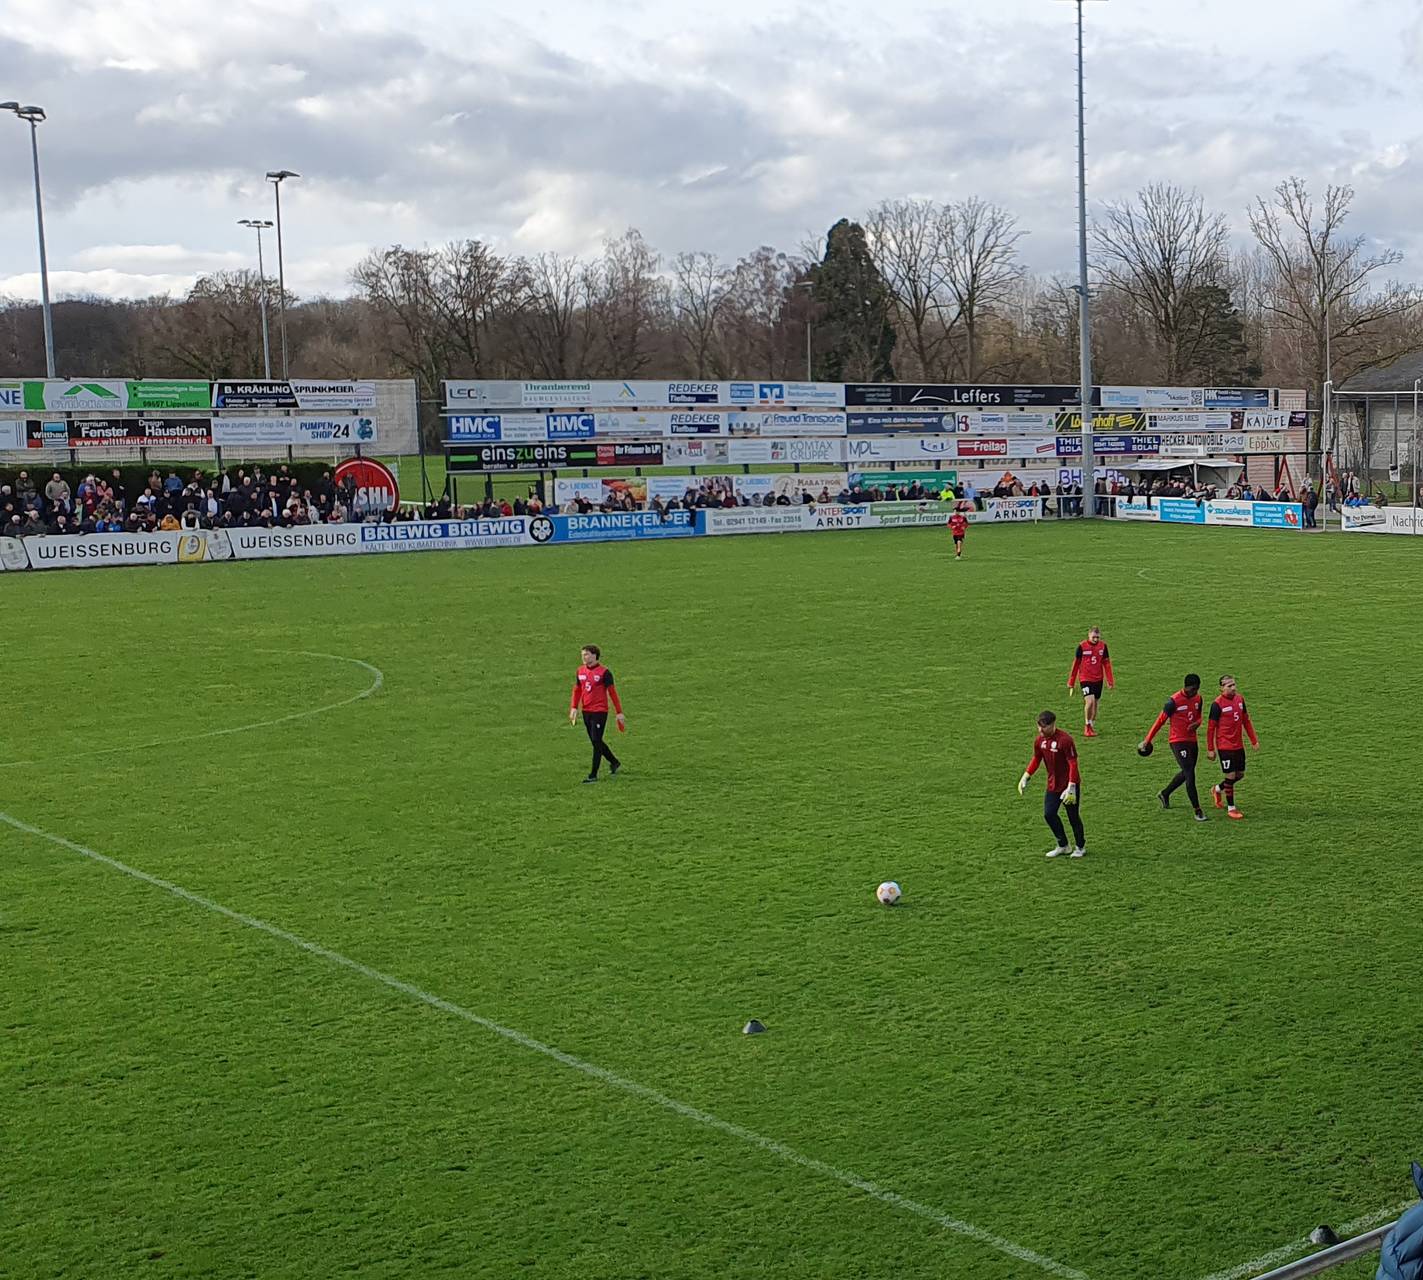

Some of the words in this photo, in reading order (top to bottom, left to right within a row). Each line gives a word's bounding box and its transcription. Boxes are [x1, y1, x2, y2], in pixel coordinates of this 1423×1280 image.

[224, 386, 235, 394] B.
[237, 384, 290, 394] KRÄHLING
[669, 384, 718, 393] REDEKER
[549, 415, 591, 431] HMC
[671, 414, 720, 423] REDEKER
[300, 422, 334, 431] PUMPEN
[333, 424, 349, 438] 24
[451, 417, 496, 433] HMC
[81, 427, 128, 438] Fenster
[145, 425, 207, 437] Haustüren
[311, 431, 333, 439] SHOP
[790, 441, 833, 450] KOMTAX
[974, 441, 1006, 453] Freitag
[481, 443, 567, 461] einszueins
[790, 450, 829, 460] GRUPPE
[995, 499, 1039, 509] INTERSPORT
[818, 506, 868, 516] INTERSPORT
[994, 508, 1034, 519] ARNDT
[816, 516, 863, 527] ARNDT
[364, 524, 442, 541] BRIEWIG
[448, 519, 522, 536] BRIEWIG
[240, 532, 357, 549] WEISSENBURG
[38, 541, 172, 559] WEISSENBURG
[1233, 712, 1239, 721] 5
[1222, 759, 1231, 769] 17
